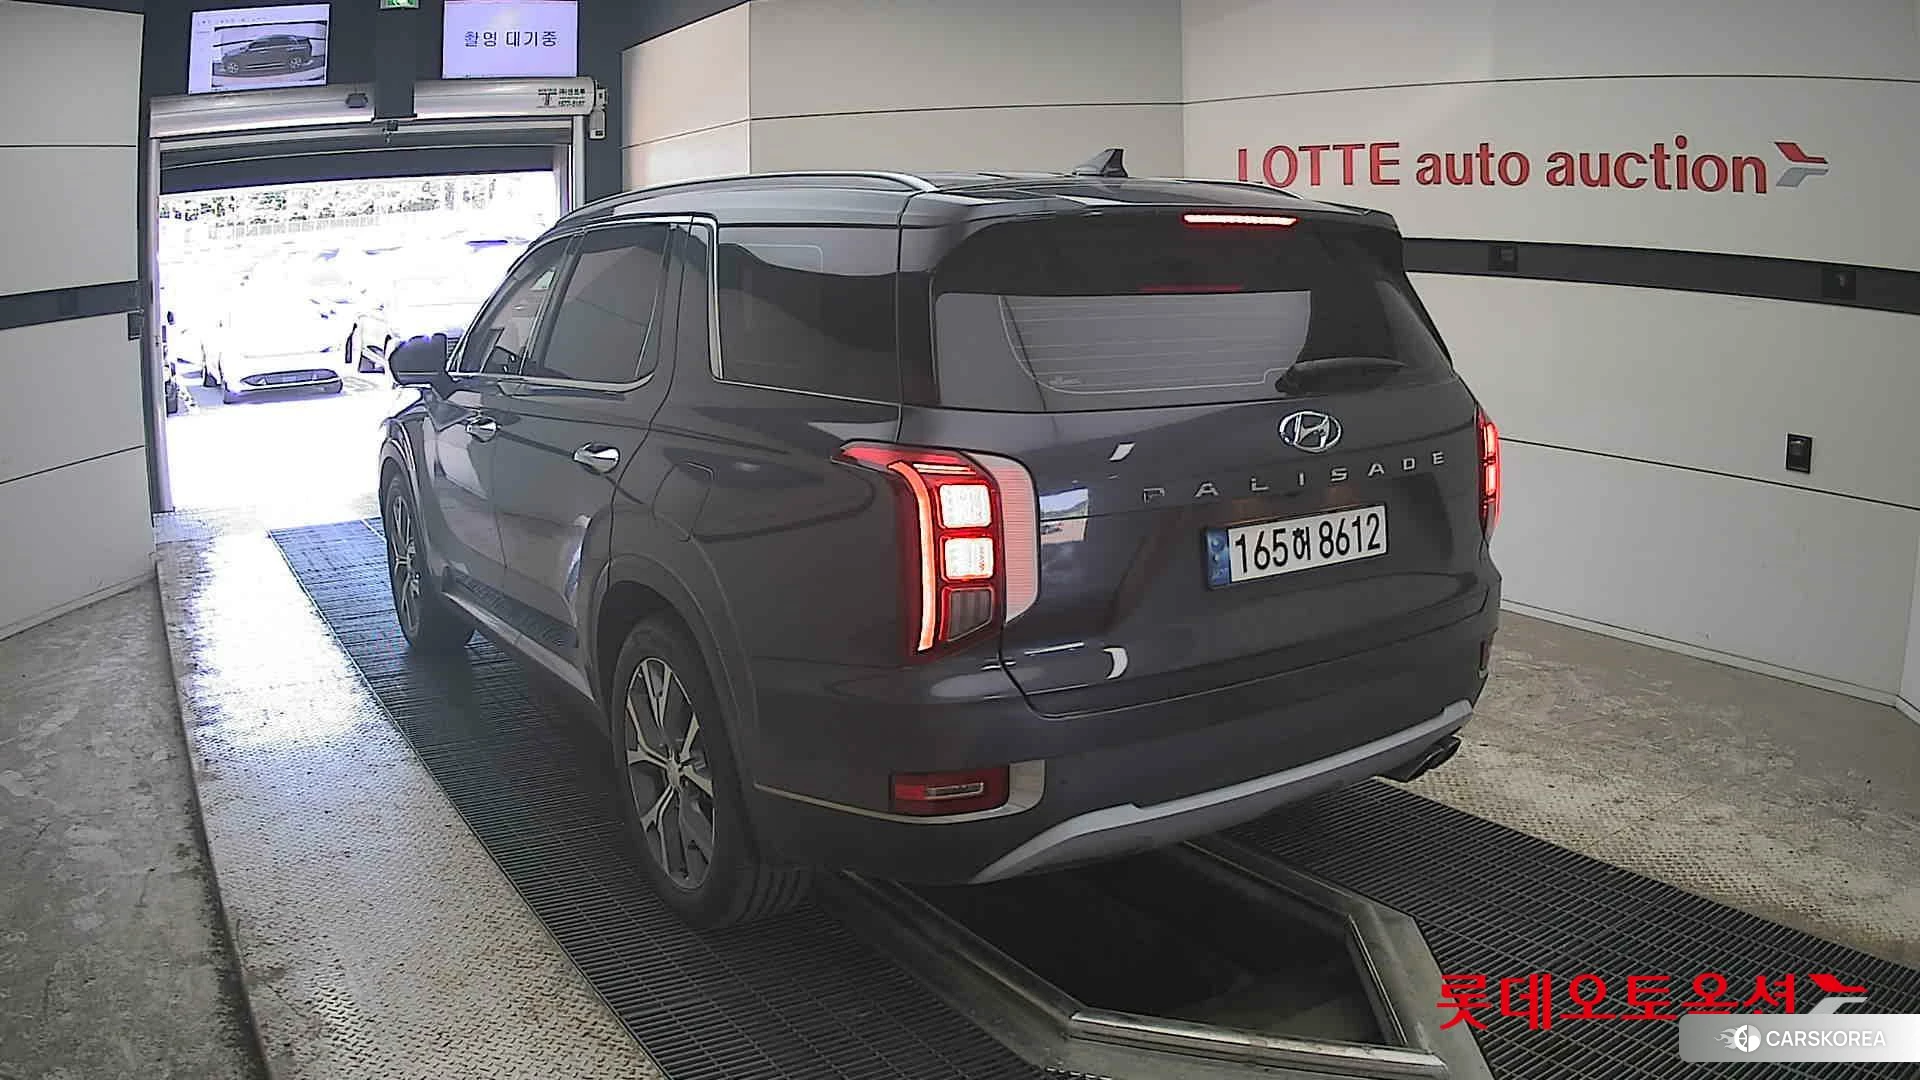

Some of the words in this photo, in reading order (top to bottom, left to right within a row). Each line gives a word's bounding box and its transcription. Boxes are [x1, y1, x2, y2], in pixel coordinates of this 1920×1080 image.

[506, 31, 557, 47] 대기중
[1238, 142, 1400, 188] LOTTE
[1415, 142, 1530, 186] auto
[1546, 135, 1768, 193] auction
[1143, 451, 1446, 503] PALISADE
